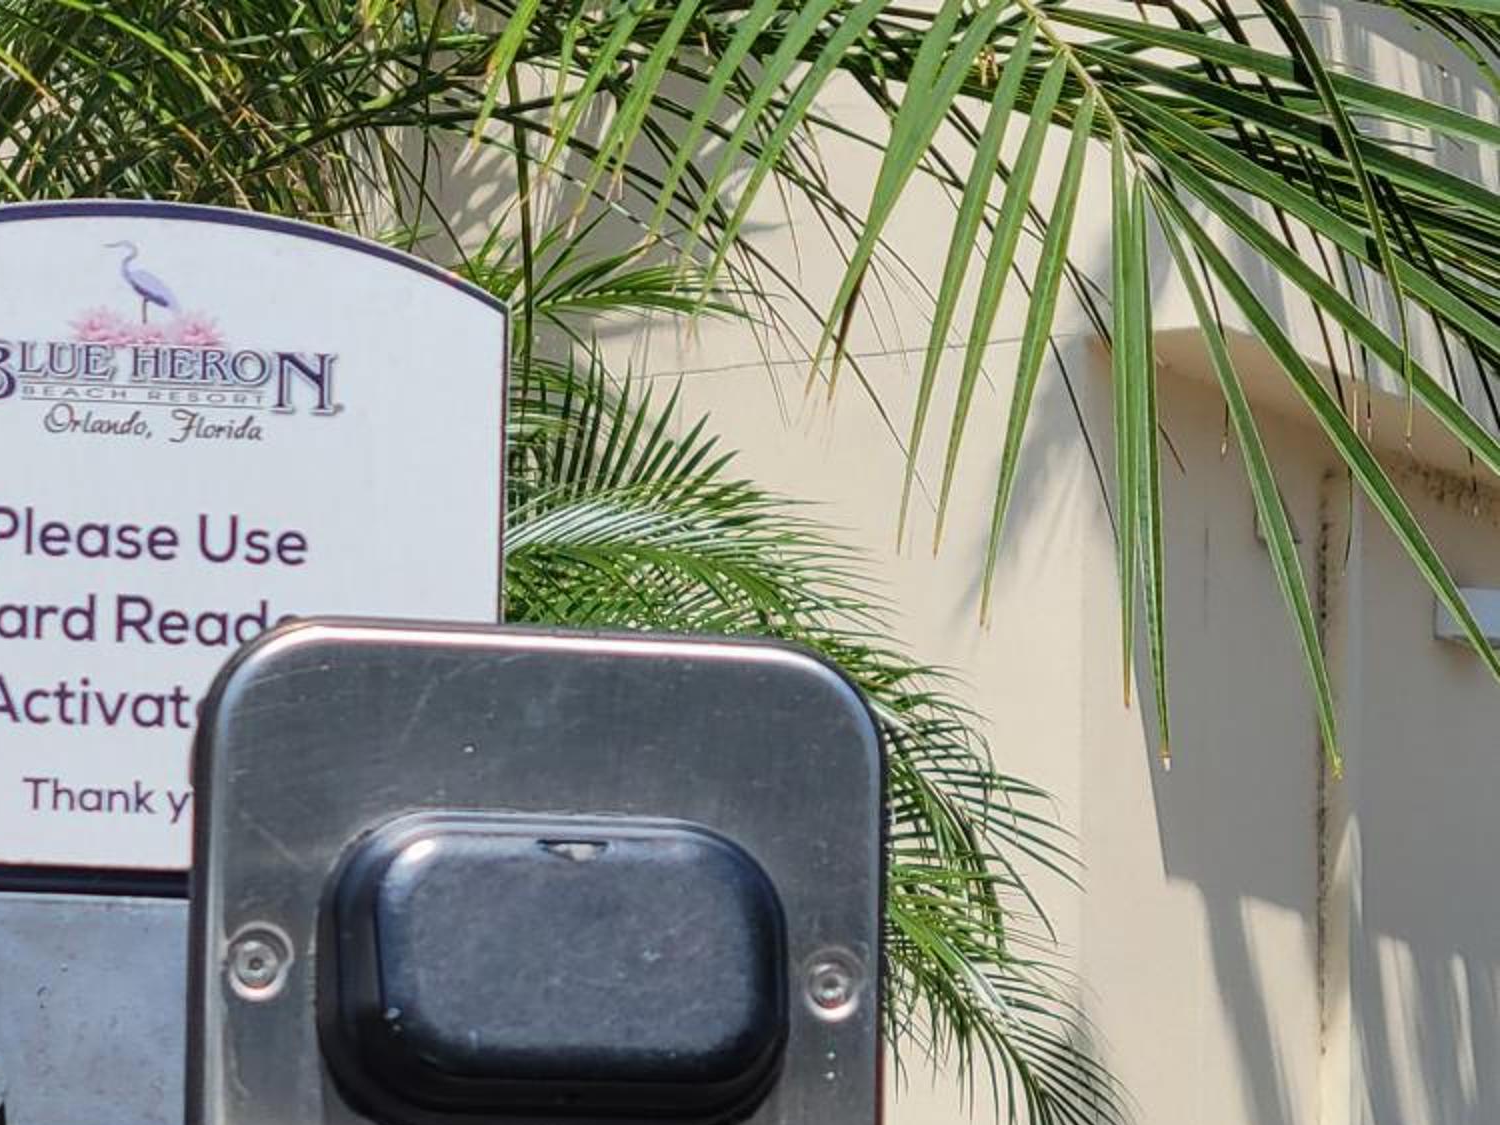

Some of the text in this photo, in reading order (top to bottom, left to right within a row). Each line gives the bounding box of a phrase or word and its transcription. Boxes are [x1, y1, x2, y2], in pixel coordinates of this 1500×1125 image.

[22, 385, 268, 405] BEACH RESORT
[131, 345, 338, 416] HERON
[43, 402, 263, 443] Orlando, Florida
[198, 513, 308, 566] Use
[115, 594, 297, 647] Read
[22, 777, 155, 814] Thank
